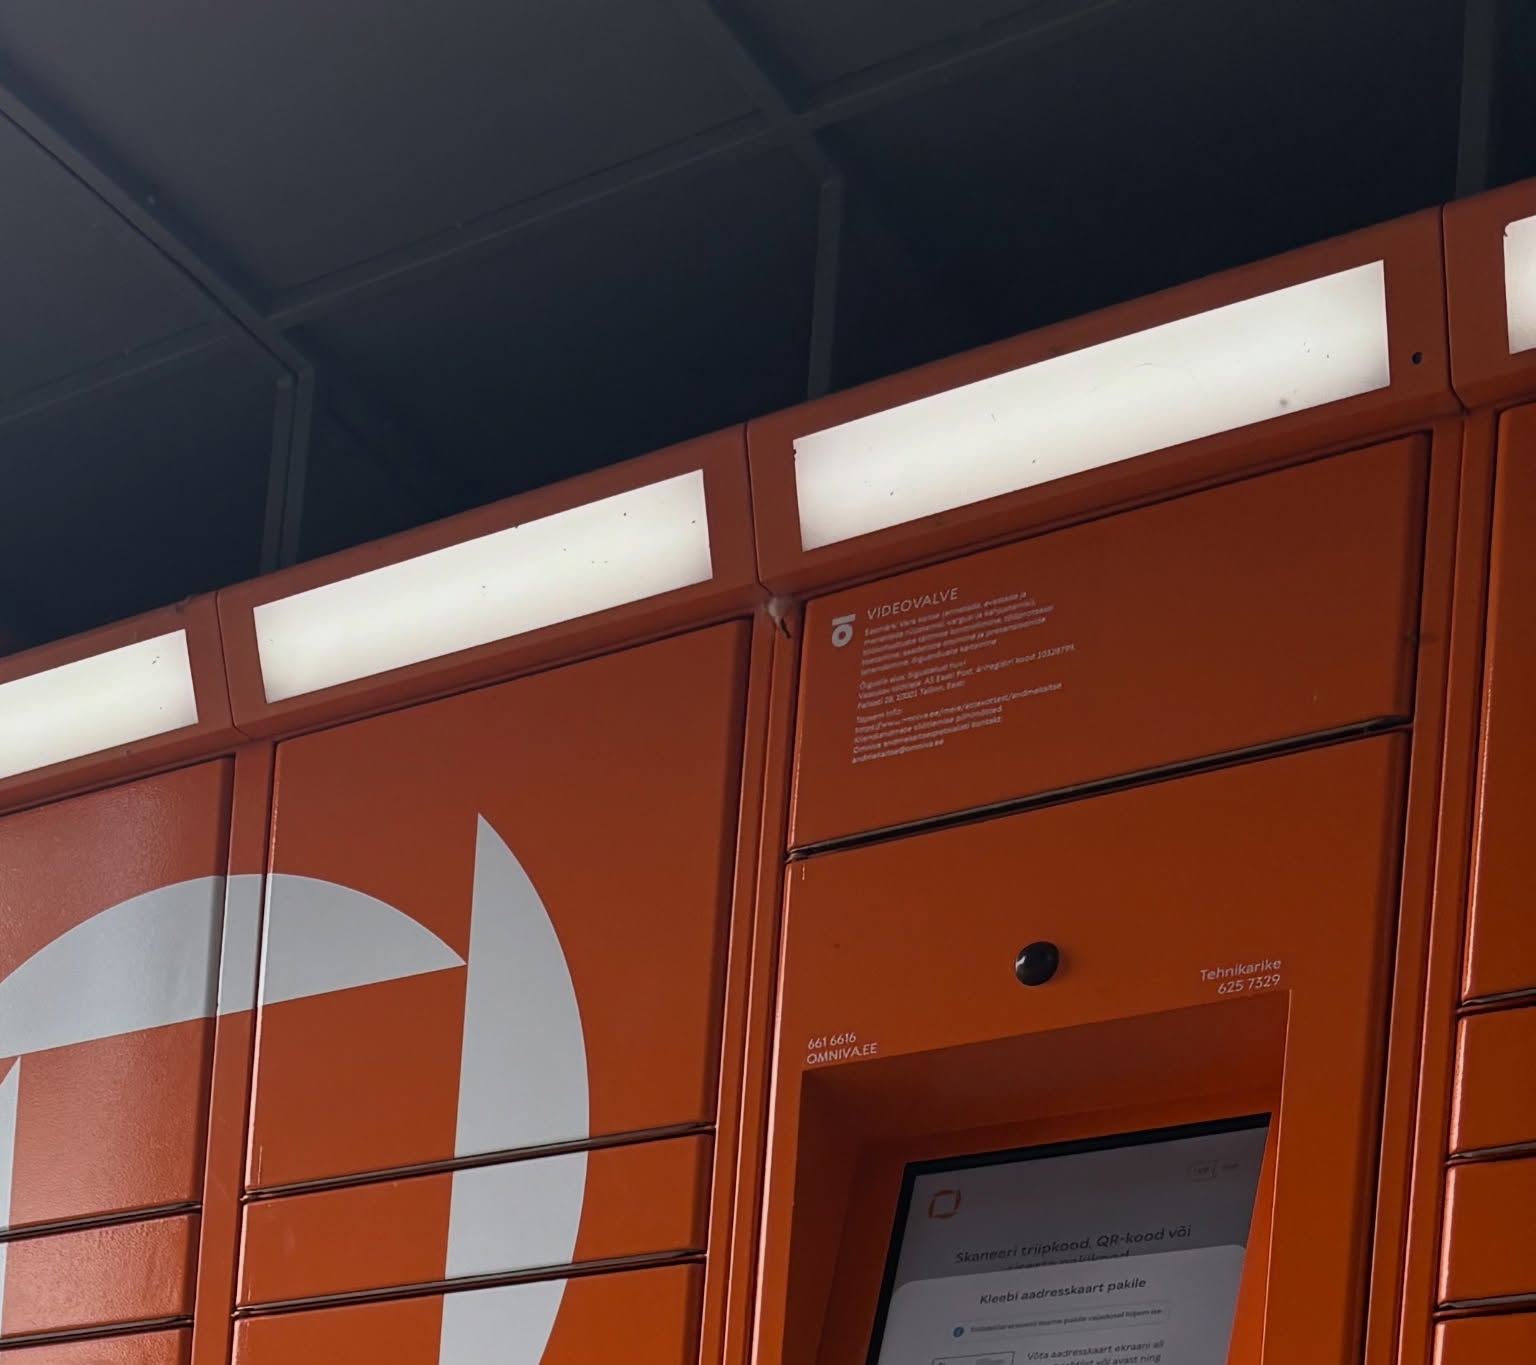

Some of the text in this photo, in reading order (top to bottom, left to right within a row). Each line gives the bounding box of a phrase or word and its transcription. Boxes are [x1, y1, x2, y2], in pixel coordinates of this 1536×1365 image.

[867, 587, 959, 620] VIDEOVALVE
[1200, 959, 1282, 982] Tehnikarike
[1218, 974, 1281, 994] 625 7329
[807, 1032, 857, 1050] 661 6616
[806, 1043, 878, 1065] OMNIVA.EE
[955, 1247, 1017, 1264] Skaneeri
[1096, 1228, 1165, 1247] QR-kood
[1169, 1224, 1192, 1239] või
[979, 1277, 1146, 1305] Kleebi aadresskaart pakile
